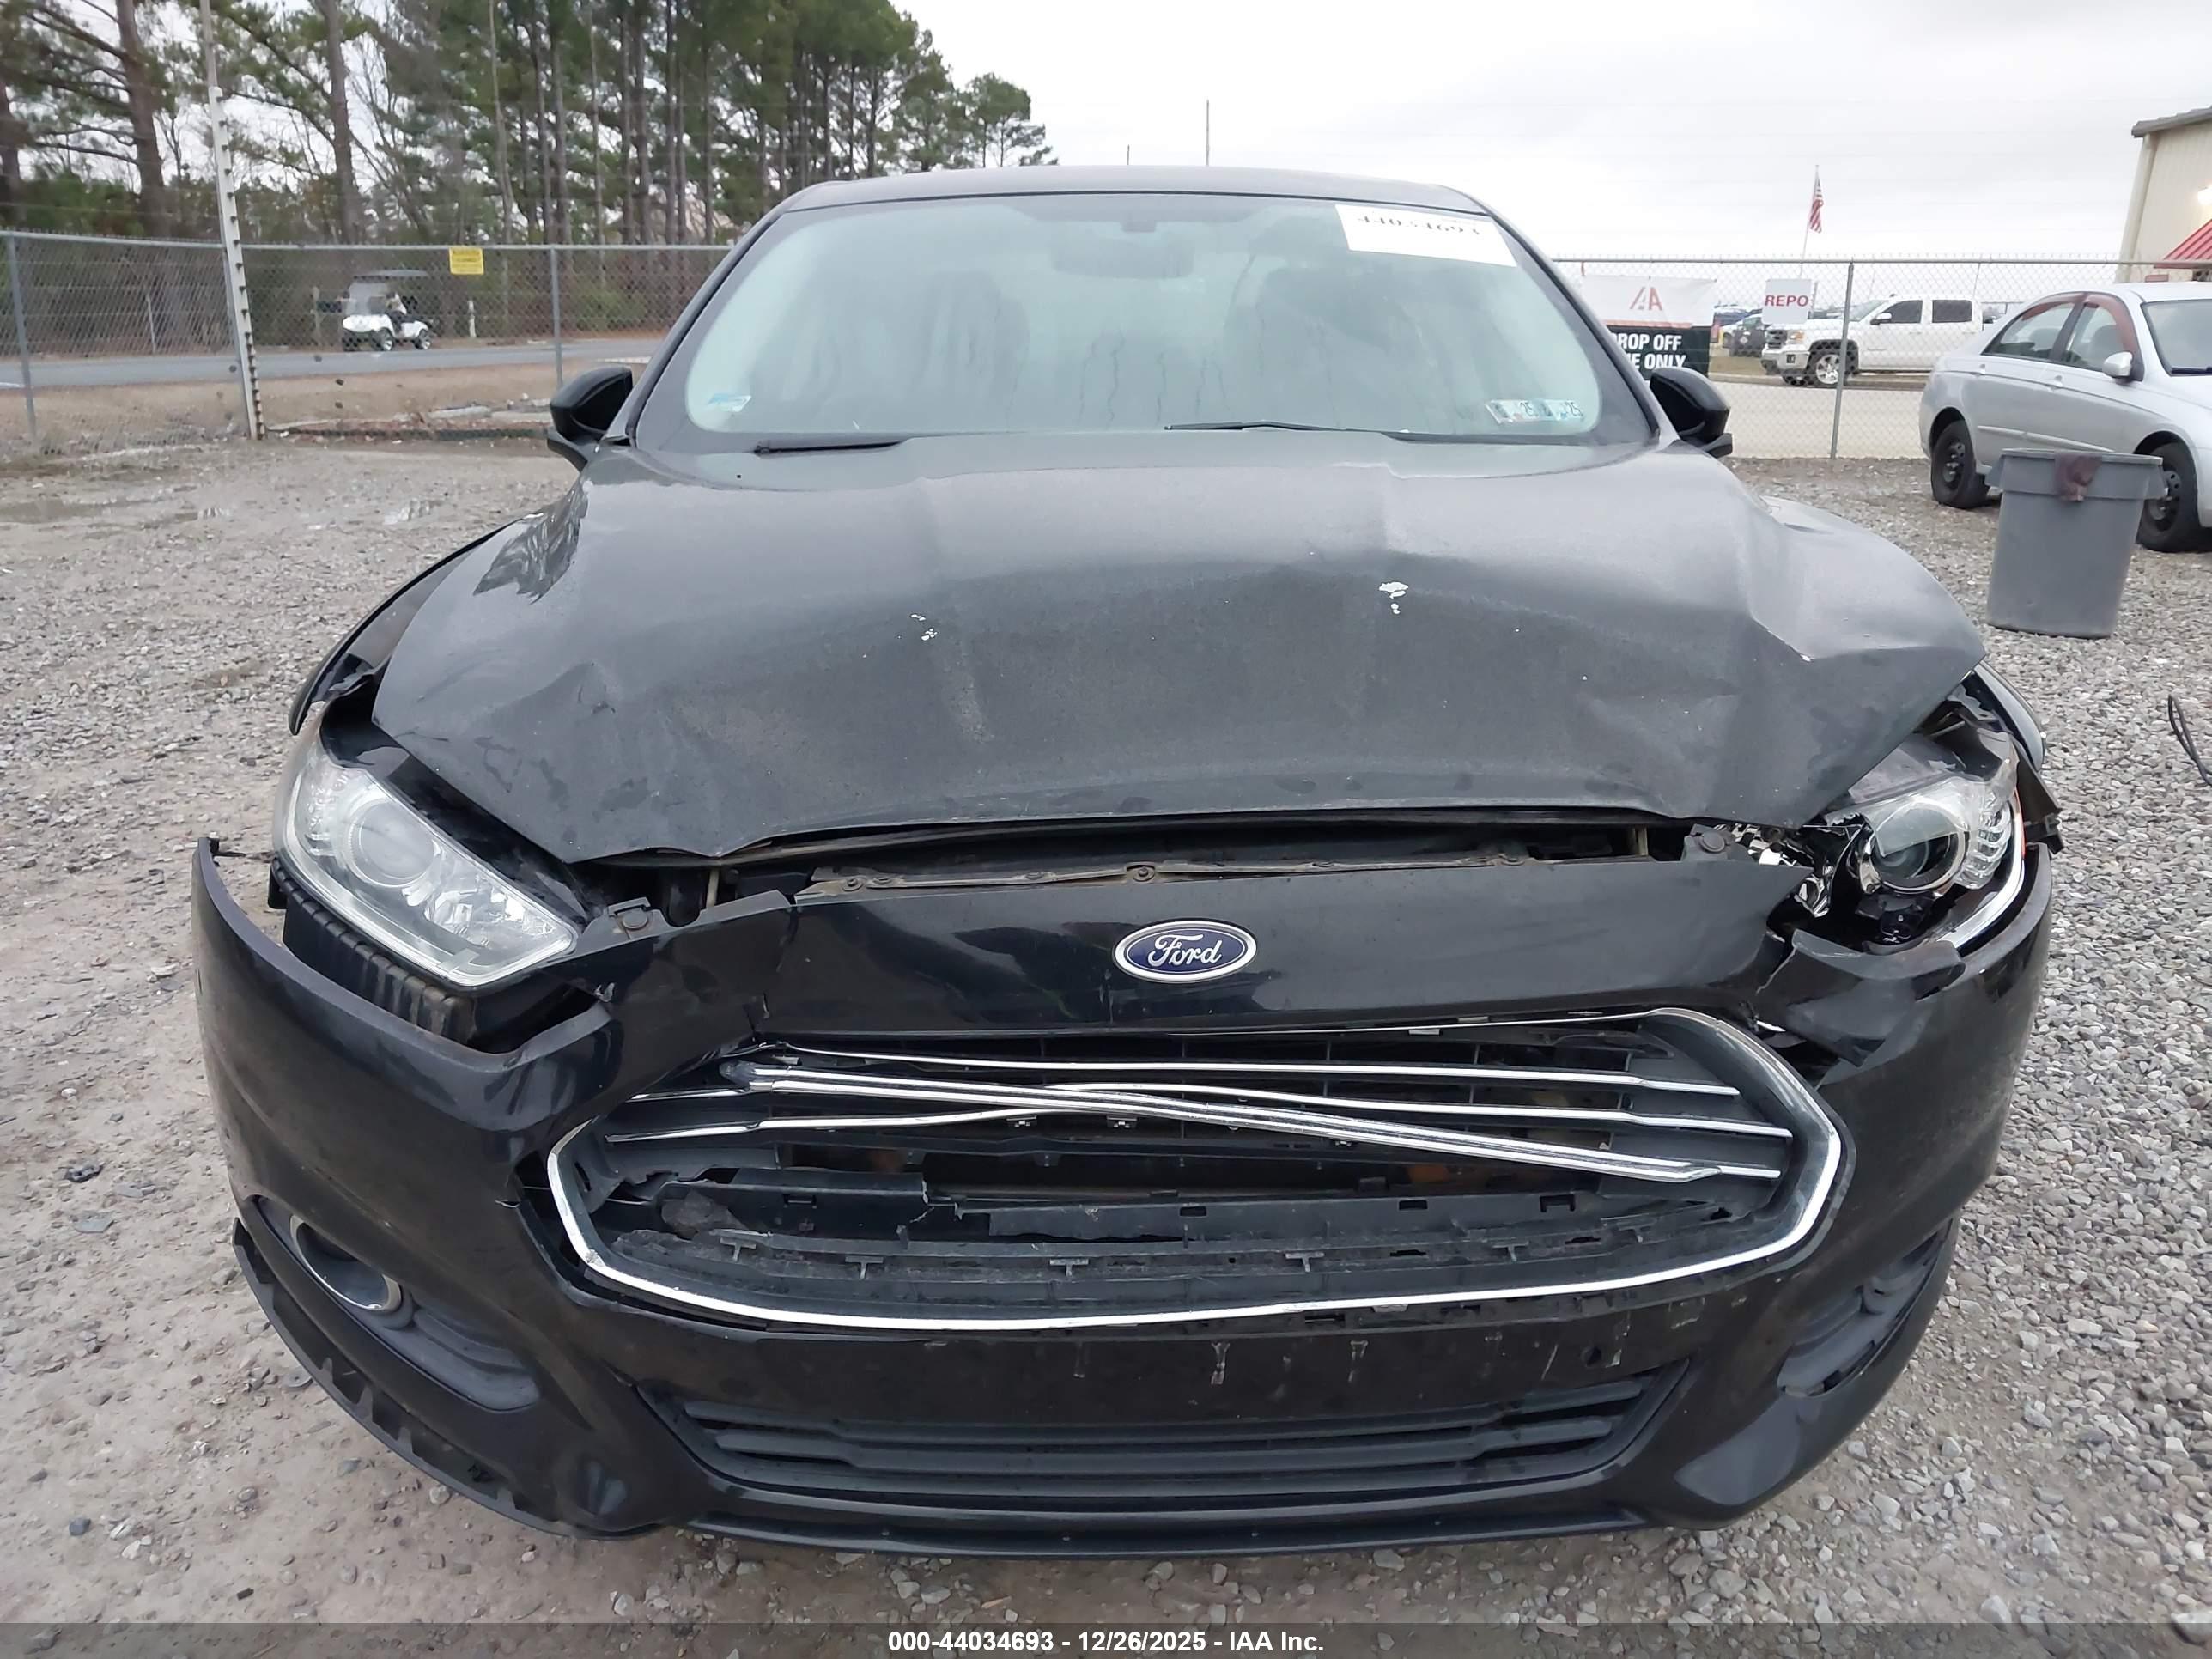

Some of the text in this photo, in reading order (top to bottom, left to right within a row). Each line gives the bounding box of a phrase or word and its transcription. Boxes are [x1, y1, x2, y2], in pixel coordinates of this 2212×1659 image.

[1765, 295, 1808, 307] REPO
[1653, 333, 1682, 351] OFF
[1644, 353, 1686, 370] ONLY
[1147, 933, 1223, 967] Ford
